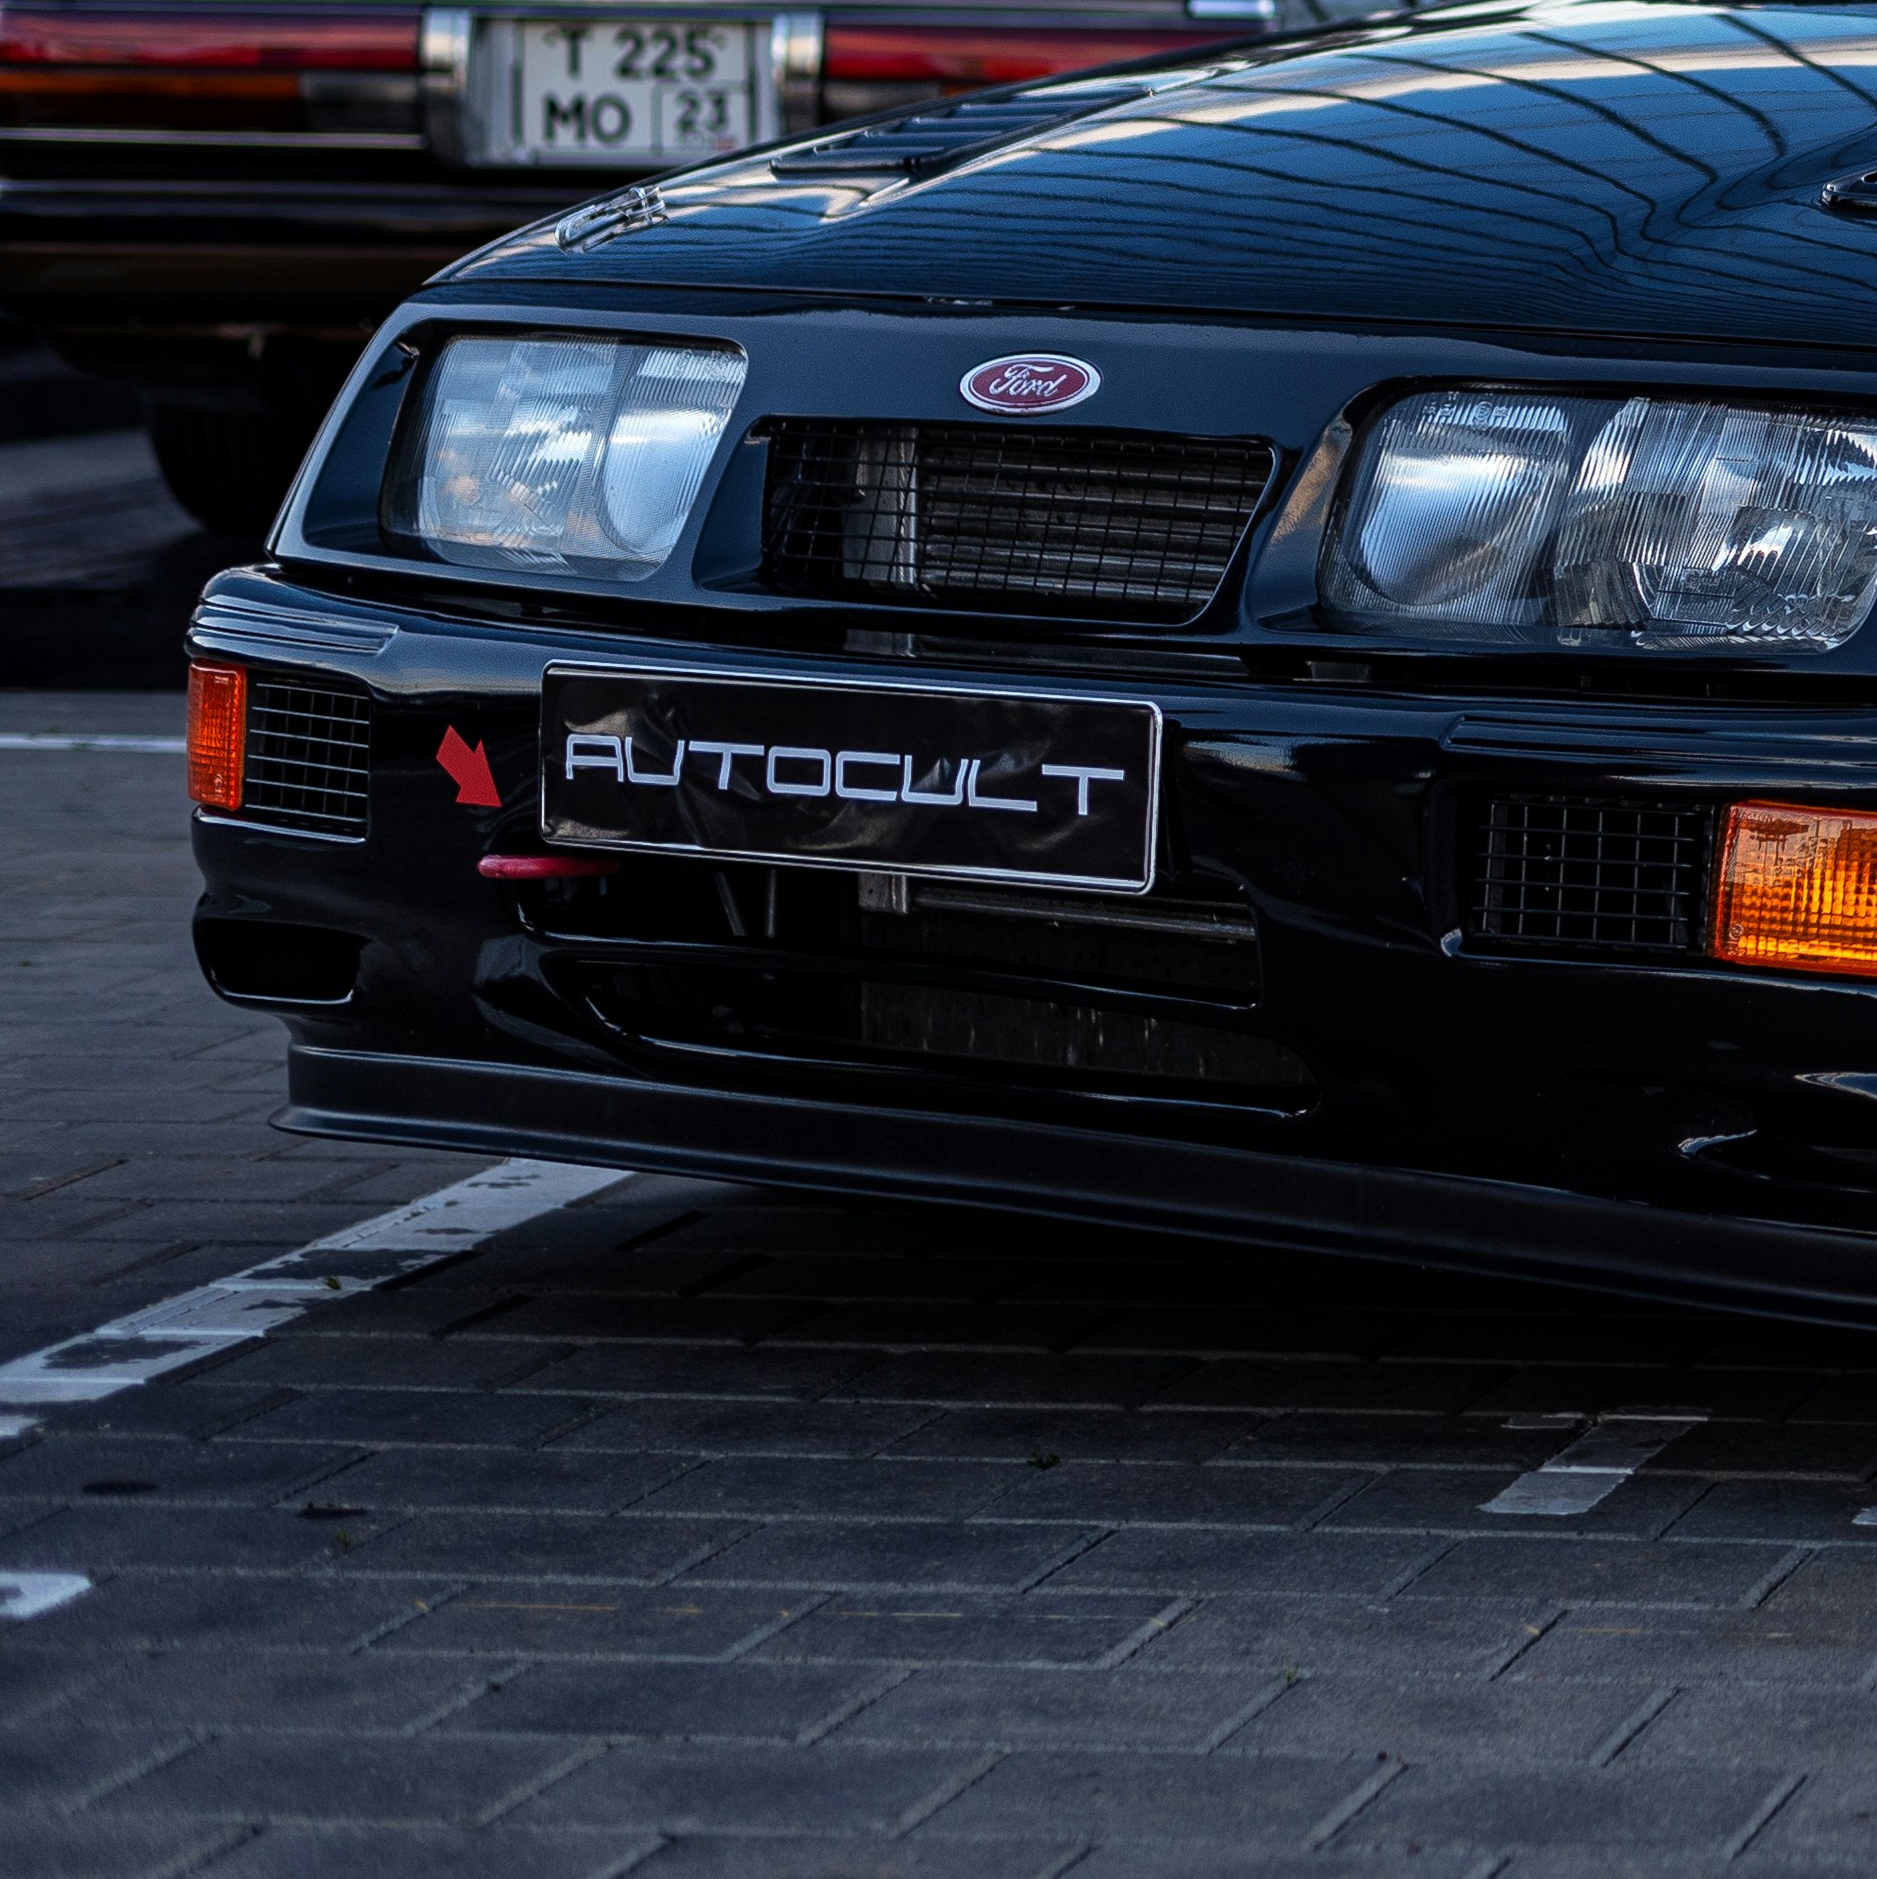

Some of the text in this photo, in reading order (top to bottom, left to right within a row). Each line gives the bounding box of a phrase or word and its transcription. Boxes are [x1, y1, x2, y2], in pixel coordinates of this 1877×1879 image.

[557, 24, 716, 82] T 225
[543, 91, 633, 144] MO
[988, 363, 1068, 397] Ford
[565, 733, 1125, 816] AUTOCULT
